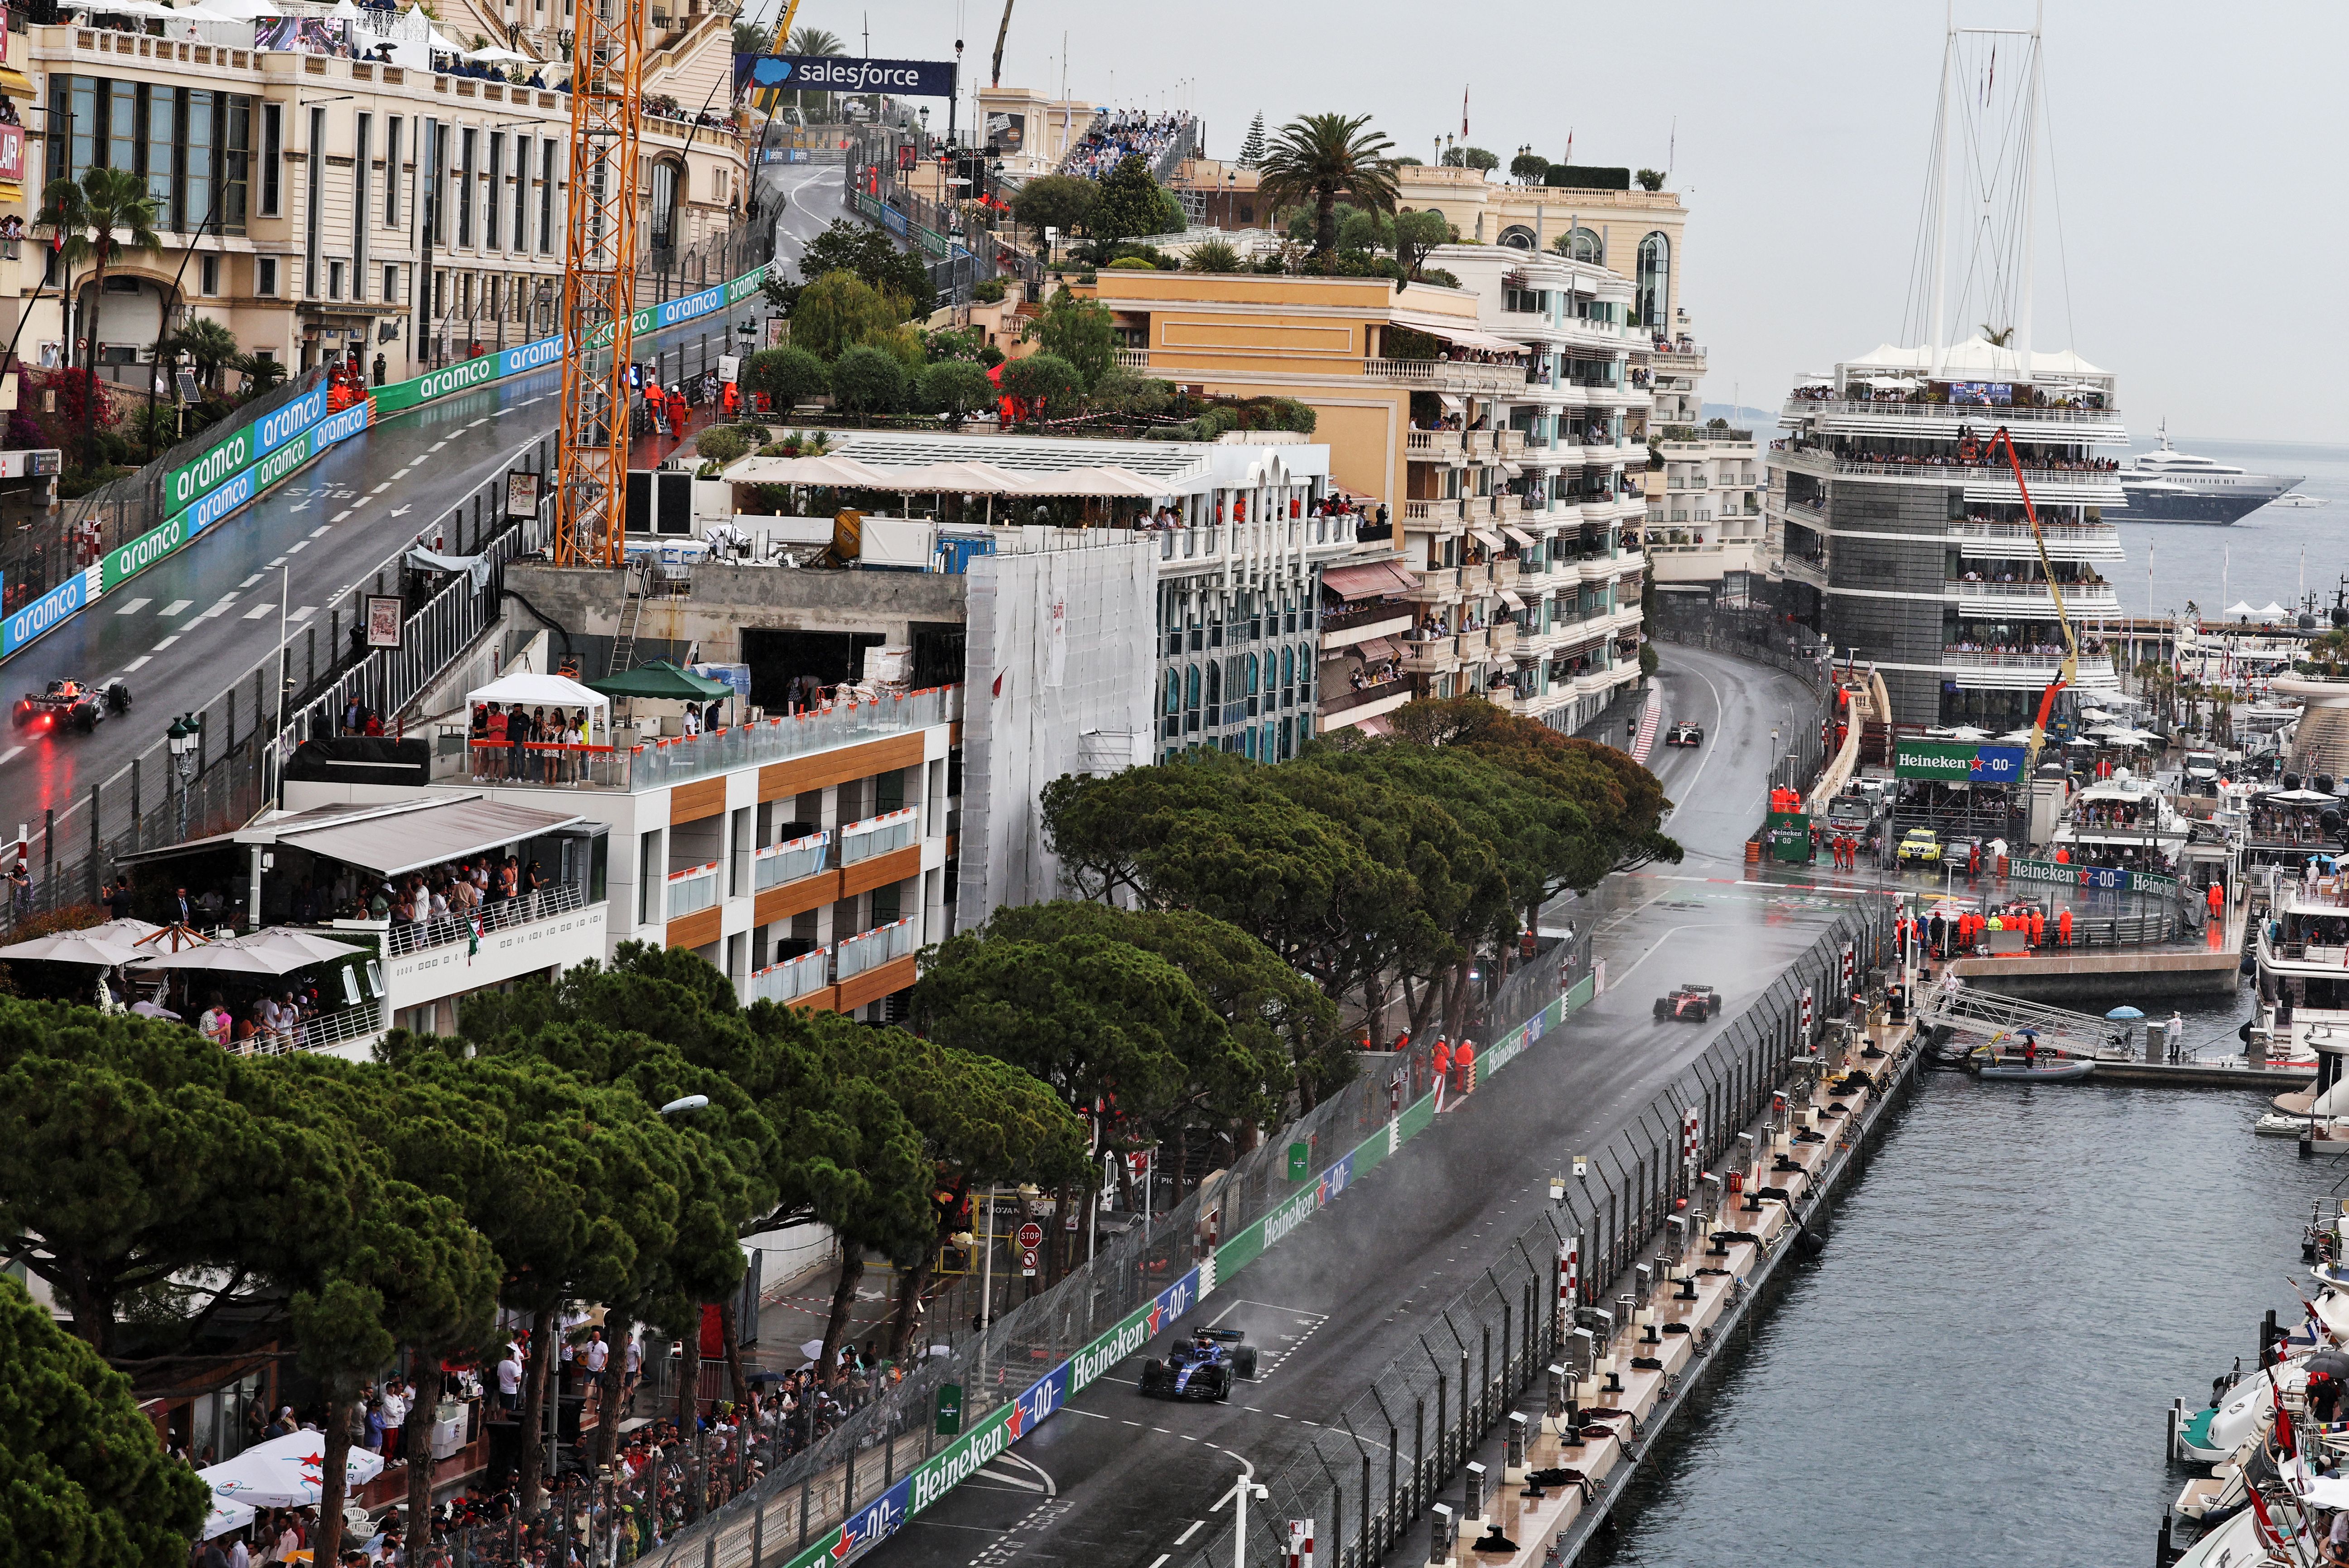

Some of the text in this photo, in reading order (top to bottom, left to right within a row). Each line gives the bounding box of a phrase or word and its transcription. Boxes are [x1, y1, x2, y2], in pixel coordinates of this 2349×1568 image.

[799, 61, 919, 89] salesforce
[992, 123, 1011, 133] MONACO
[770, 148, 782, 162] salesforce
[794, 149, 807, 163] salesforce
[861, 198, 879, 217] aramco
[884, 211, 903, 232] aramco
[922, 227, 943, 254] aramco
[730, 272, 760, 299] aramco
[666, 291, 717, 321] aramco
[421, 360, 489, 398] aramco
[264, 392, 320, 447] aramco
[317, 408, 362, 447] aramco
[177, 436, 245, 501] aramco
[261, 440, 304, 484] aramco
[198, 478, 247, 525] aramco
[120, 521, 179, 574] aramco
[2040, 546, 2052, 576] RIWAL.COM
[14, 584, 76, 642] aramco
[30, 693, 68, 702] ORACLE
[1899, 754, 1966, 769] Heineken
[2011, 859, 2074, 883] Heineken
[2132, 874, 2176, 898] Heineken
[1488, 1036, 1521, 1075] Heineken
[1263, 1189, 1314, 1250] Heineken
[1072, 1321, 1144, 1394] Heineken
[913, 1424, 1002, 1514] Heineken
